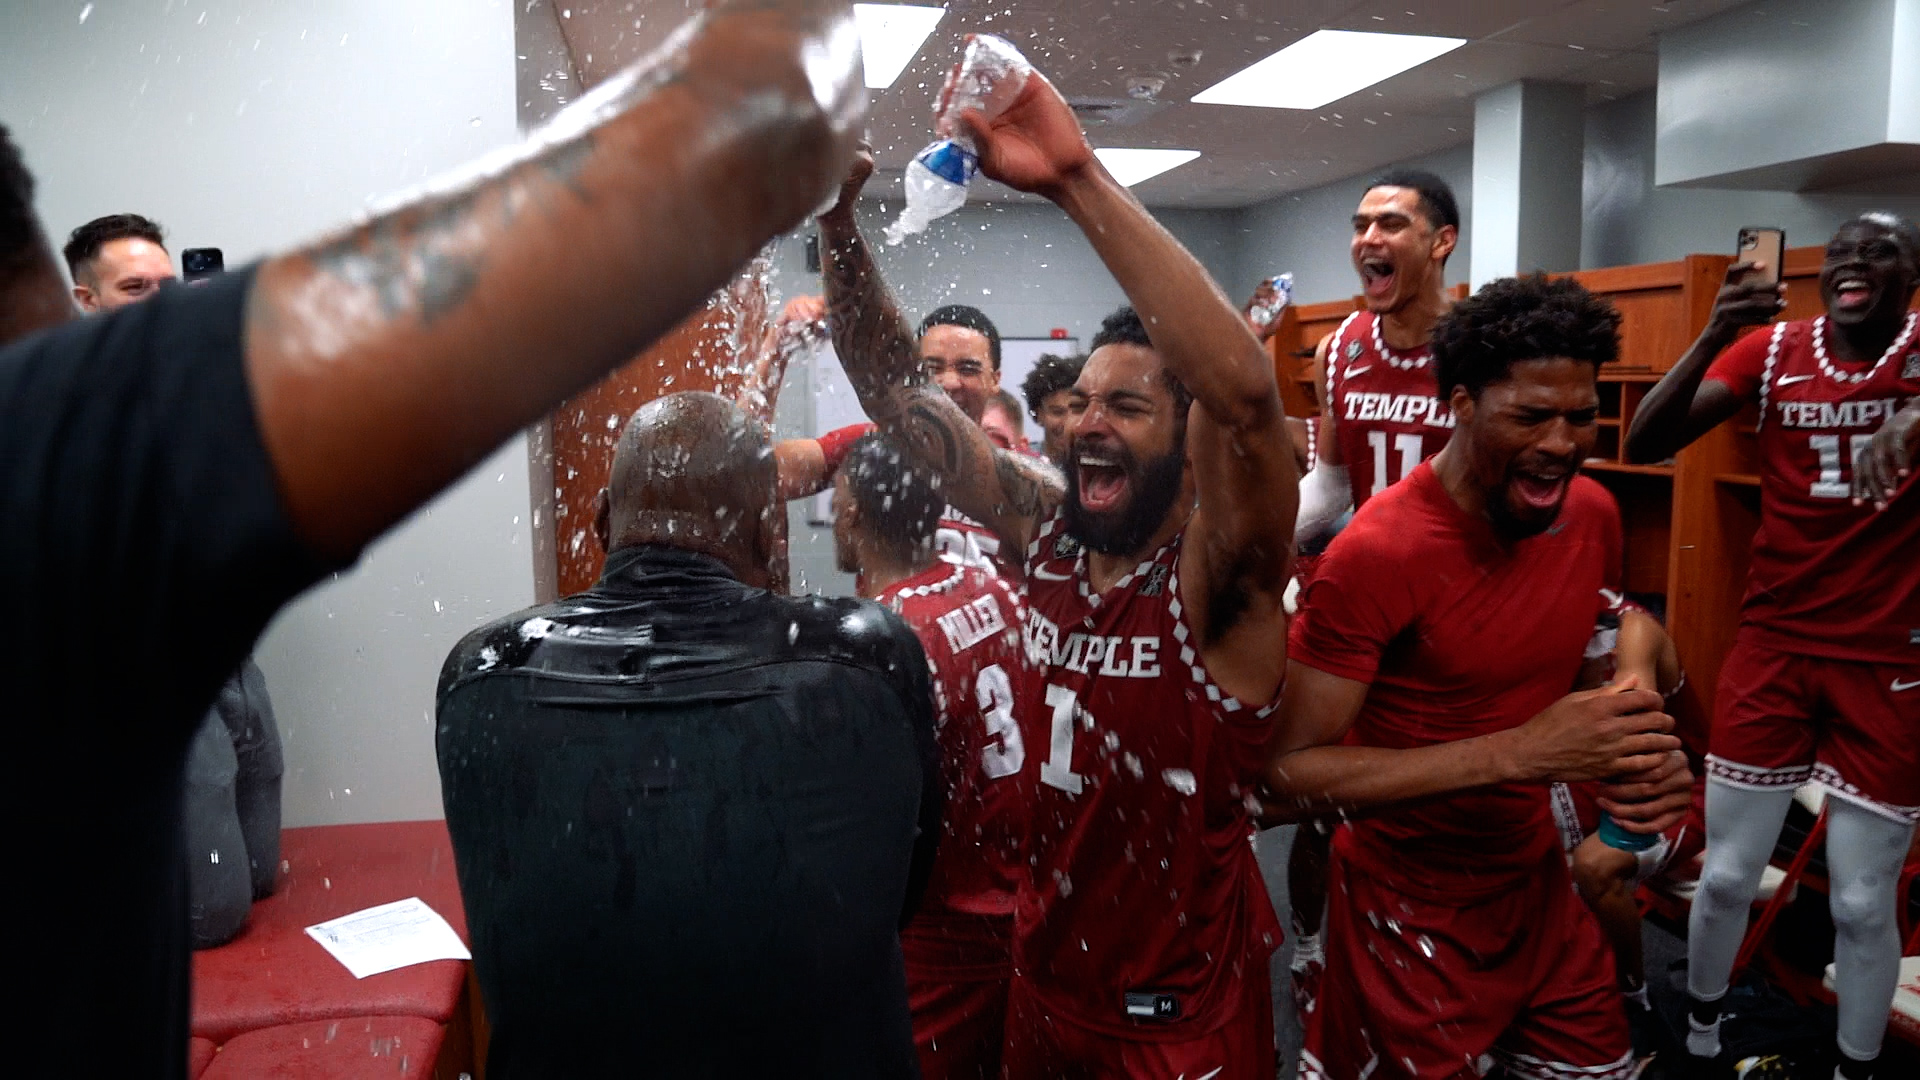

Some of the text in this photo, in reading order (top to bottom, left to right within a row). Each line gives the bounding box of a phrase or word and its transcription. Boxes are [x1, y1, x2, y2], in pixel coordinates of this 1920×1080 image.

[1344, 391, 1457, 429] TEMPL
[1777, 398, 1897, 428] TEMP
[1367, 430, 1423, 497] 11
[936, 593, 1008, 655] MILLER
[1023, 605, 1161, 678] TEMPLE
[975, 663, 1025, 780] 3
[1040, 683, 1083, 795] 1
